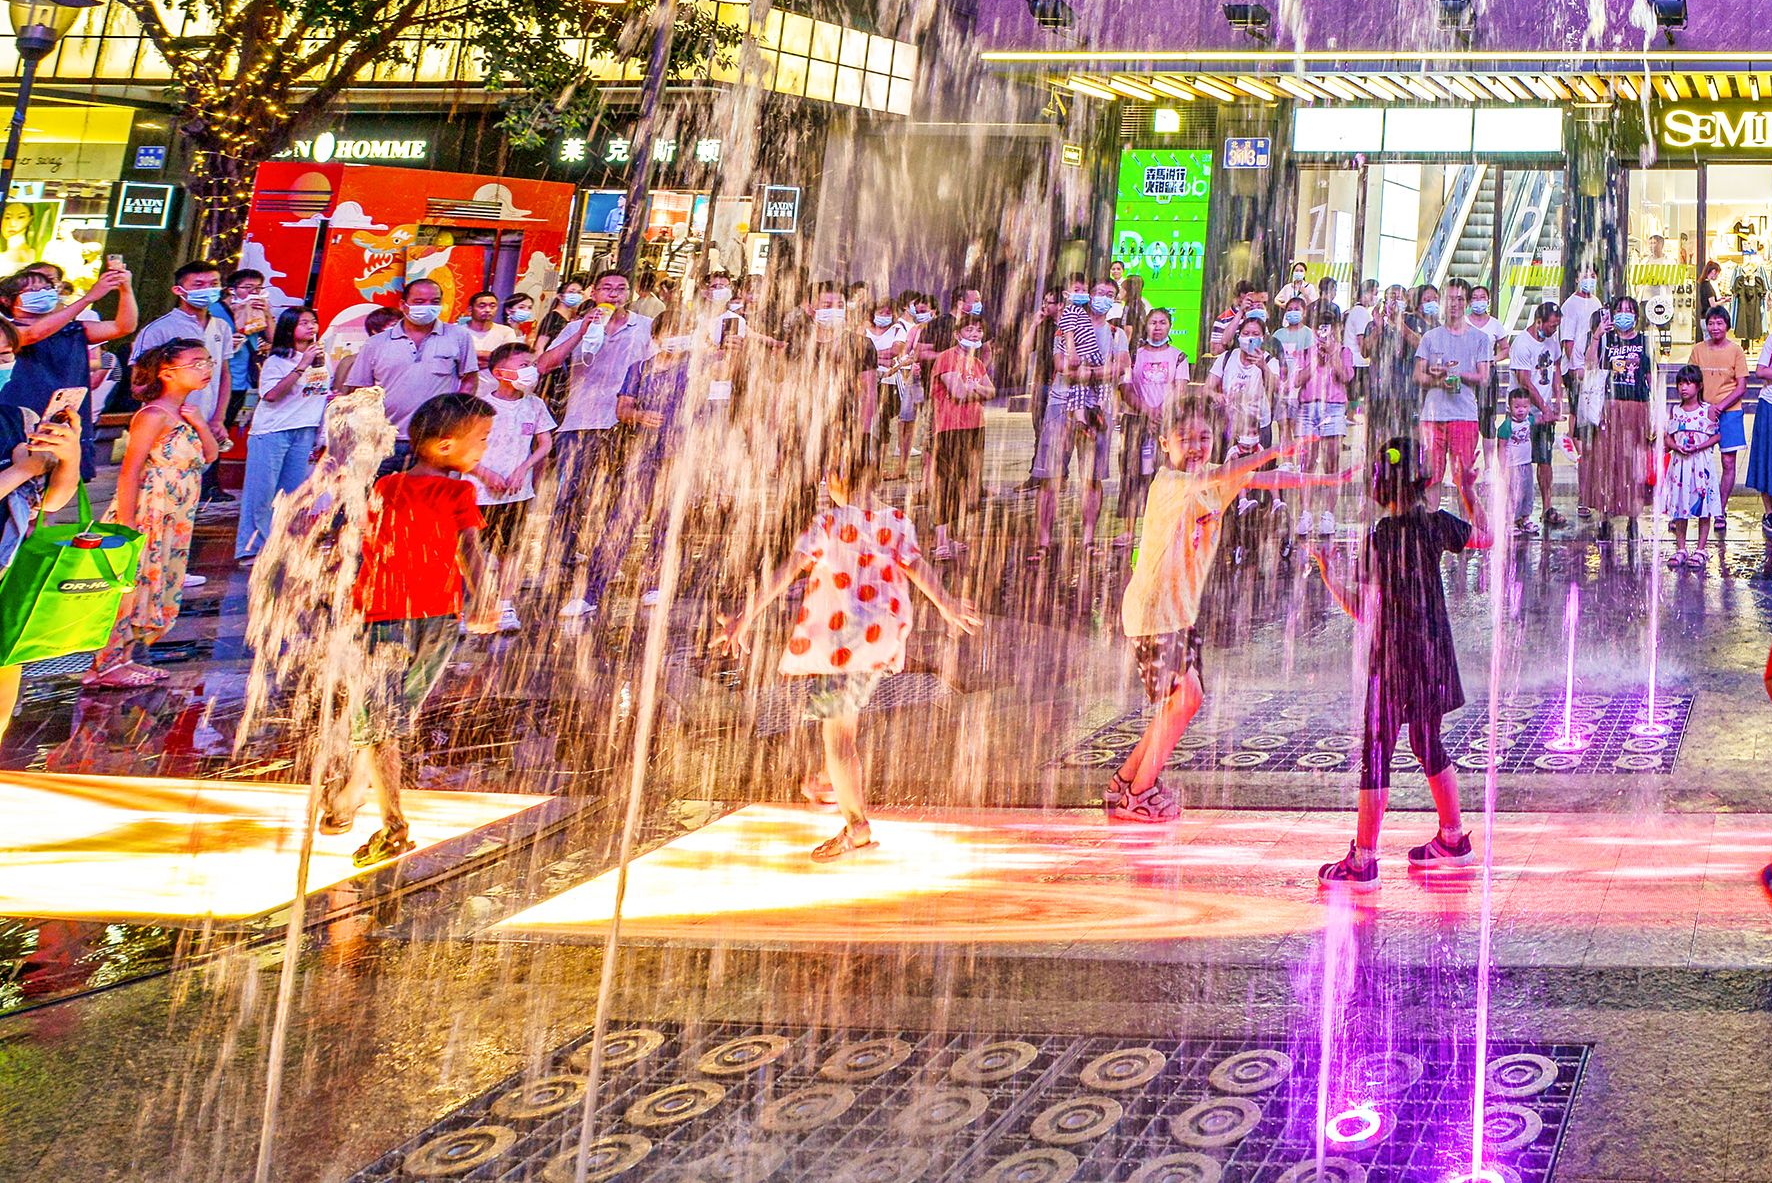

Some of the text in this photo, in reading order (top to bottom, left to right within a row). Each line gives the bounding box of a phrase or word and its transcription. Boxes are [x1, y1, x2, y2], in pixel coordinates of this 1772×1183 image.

[333, 140, 428, 159] HOMME
[559, 138, 722, 164] 莱克斯顿
[1608, 345, 1643, 356] FRIENDS
